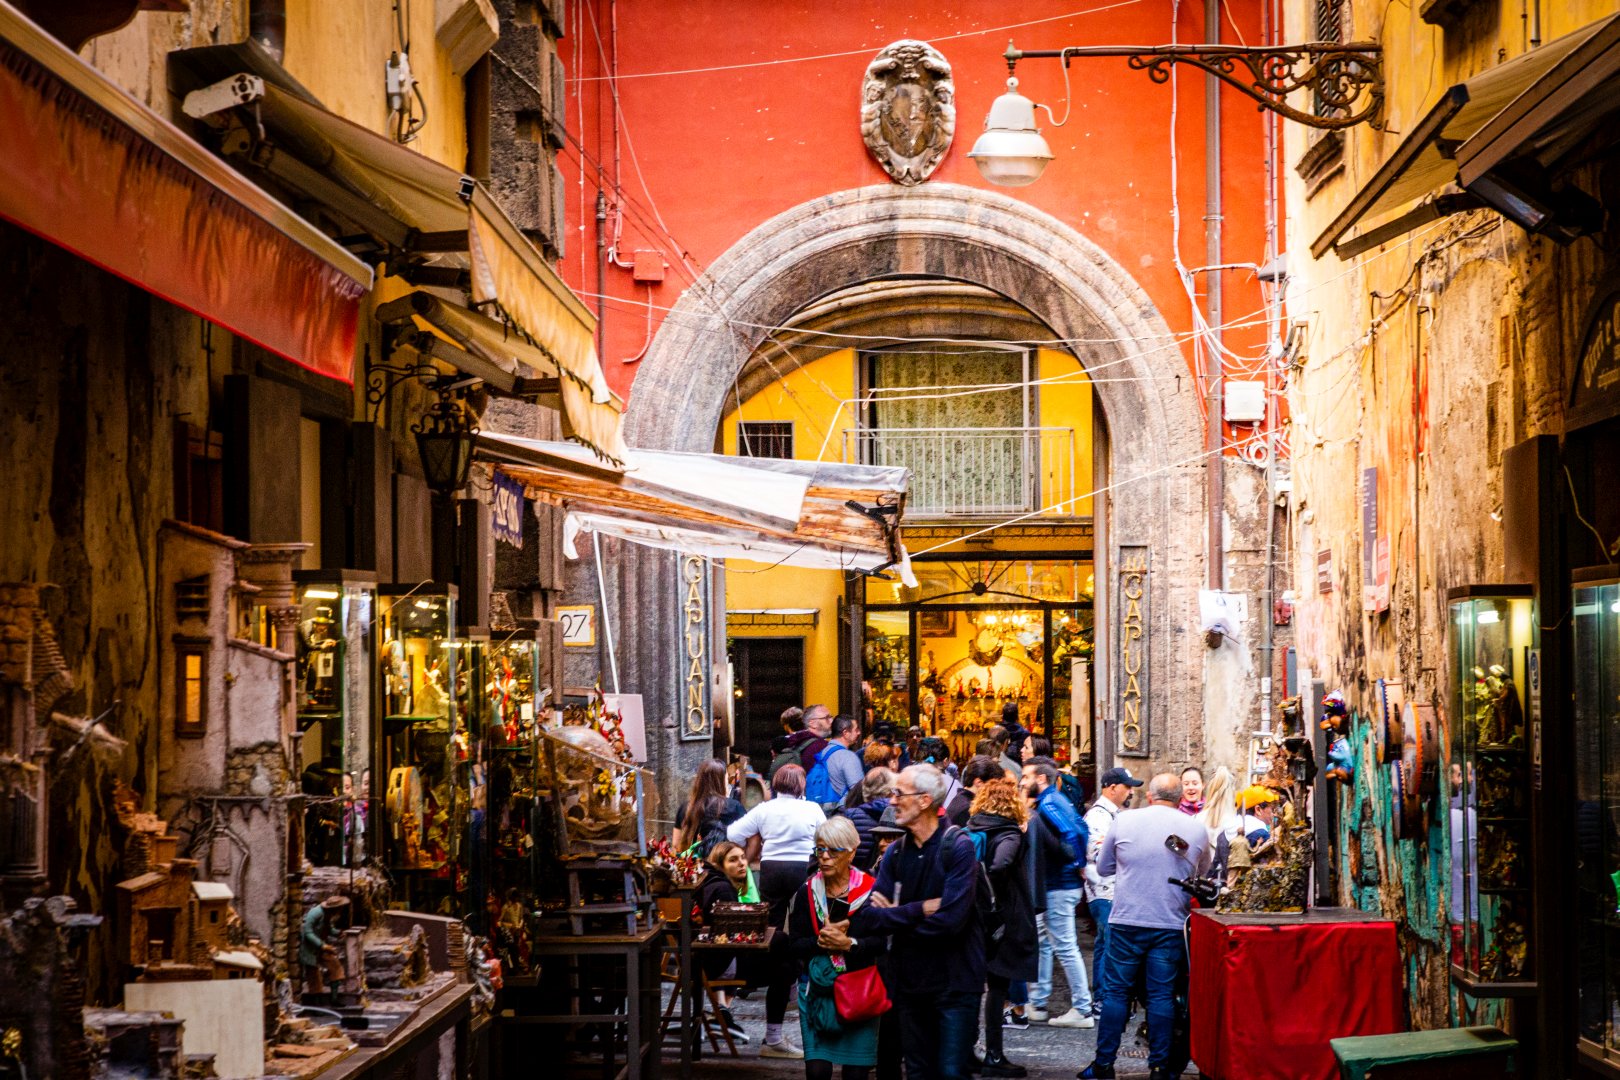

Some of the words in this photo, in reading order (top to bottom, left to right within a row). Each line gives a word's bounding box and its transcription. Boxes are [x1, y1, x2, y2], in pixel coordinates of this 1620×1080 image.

[560, 613, 588, 638] 27
[683, 556, 704, 732] CAPUANO
[1123, 573, 1142, 748] CAPUANO
